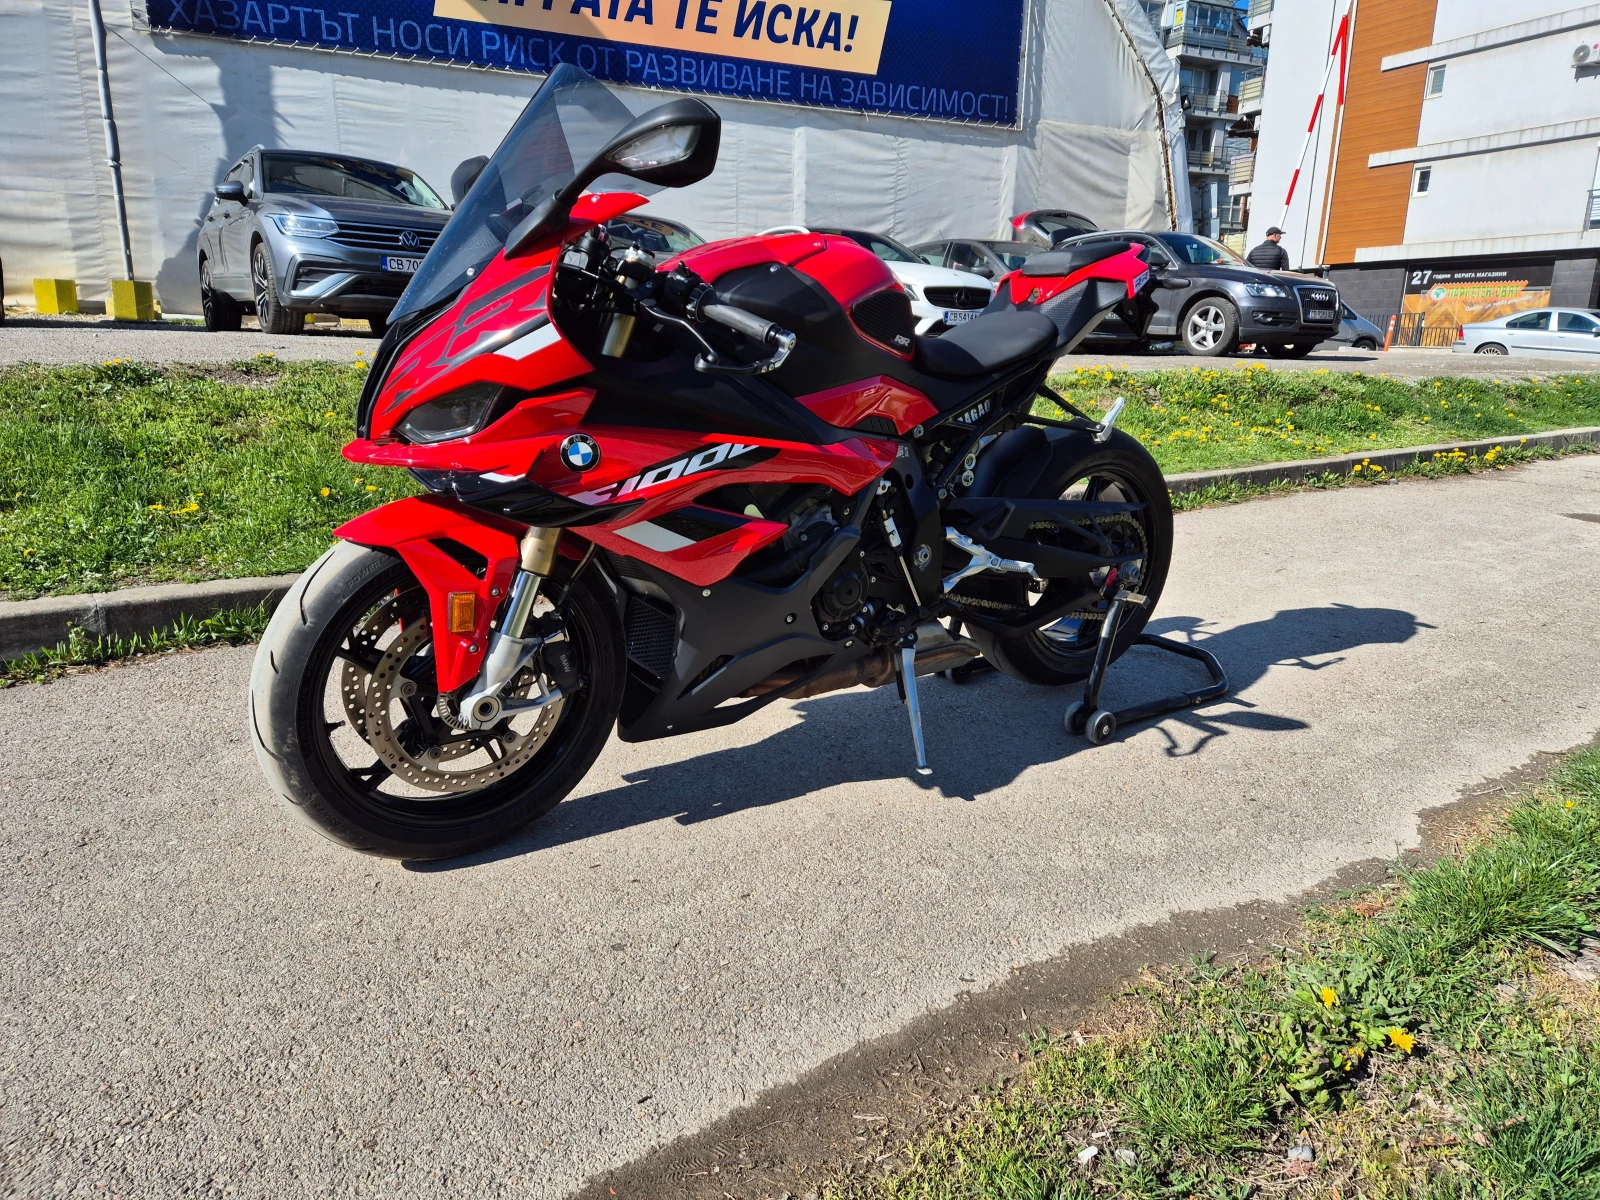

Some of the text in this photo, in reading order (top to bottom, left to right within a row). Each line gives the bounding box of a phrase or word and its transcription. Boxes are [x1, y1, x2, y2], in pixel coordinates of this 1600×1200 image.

[732, 3, 860, 53] ИСКА!
[168, 0, 1009, 119] ХАЗАРТЪТ НОСИ РИСК ОТ РАЗВИВАНЕ НА ЗАВИСИМОСТ!
[1411, 270, 1432, 285] 27
[1448, 285, 1520, 299] ПАРКЕТЕН СВЯТ
[560, 654, 571, 672] BMW
